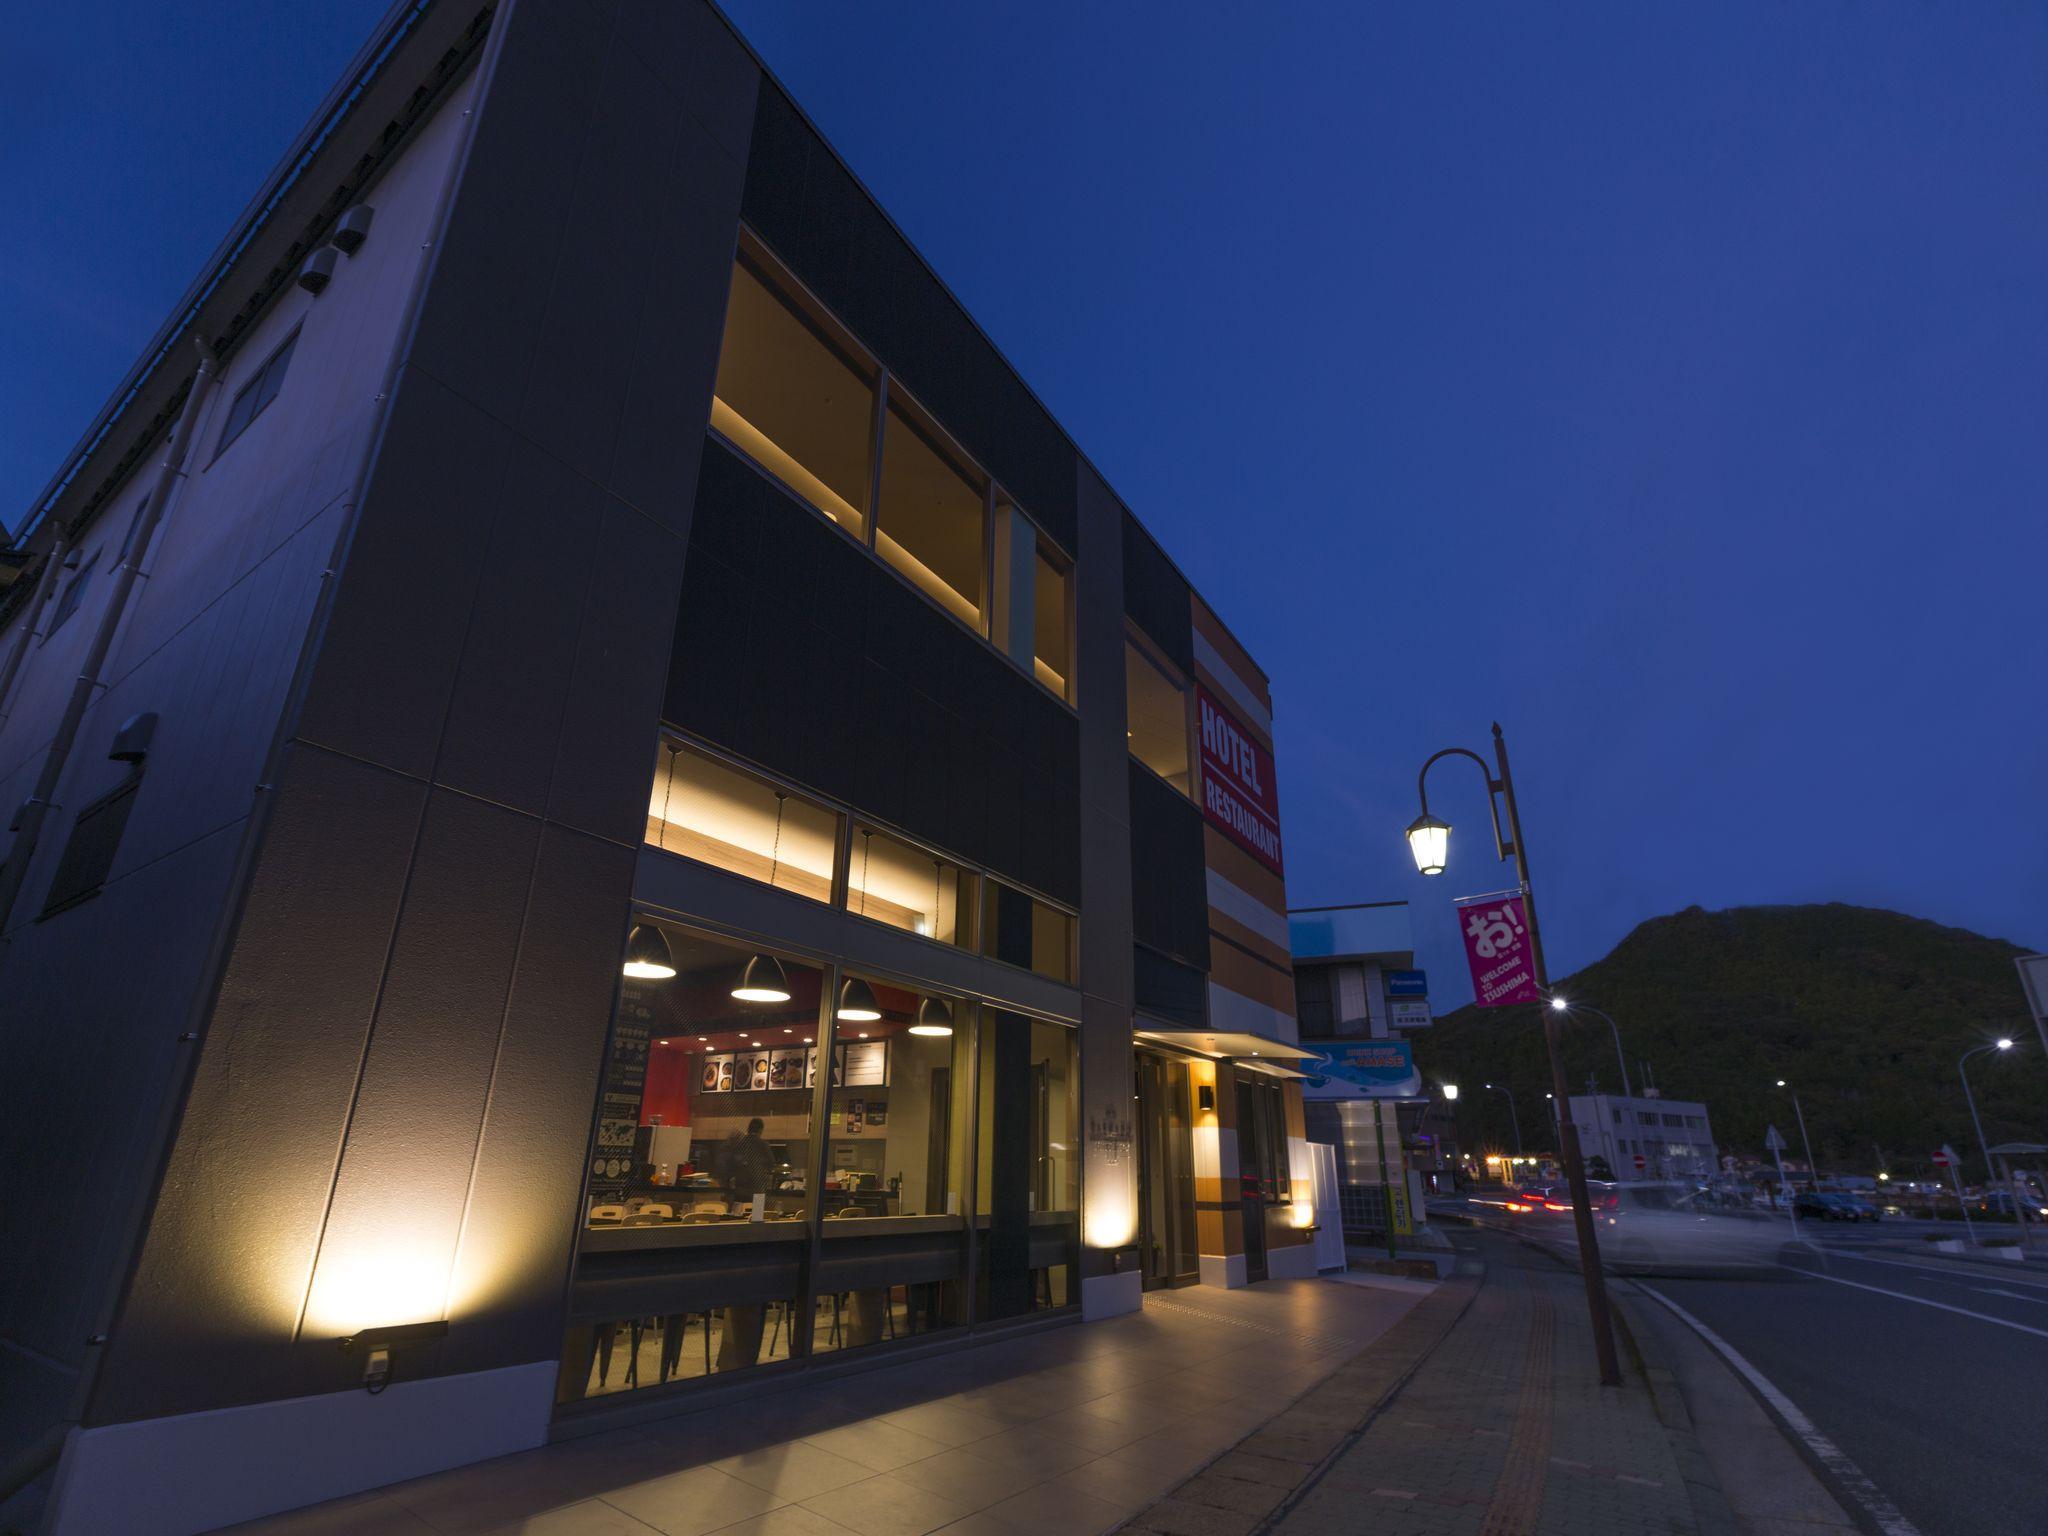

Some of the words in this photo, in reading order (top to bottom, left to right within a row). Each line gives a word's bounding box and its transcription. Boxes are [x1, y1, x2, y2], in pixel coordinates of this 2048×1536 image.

[1200, 697, 1262, 798] HOTEL
[1205, 776, 1280, 864] RESTAURANT
[1480, 956, 1522, 983] WELCOME
[1481, 983, 1494, 993] TO
[1482, 972, 1530, 1002] TSUSHIMA
